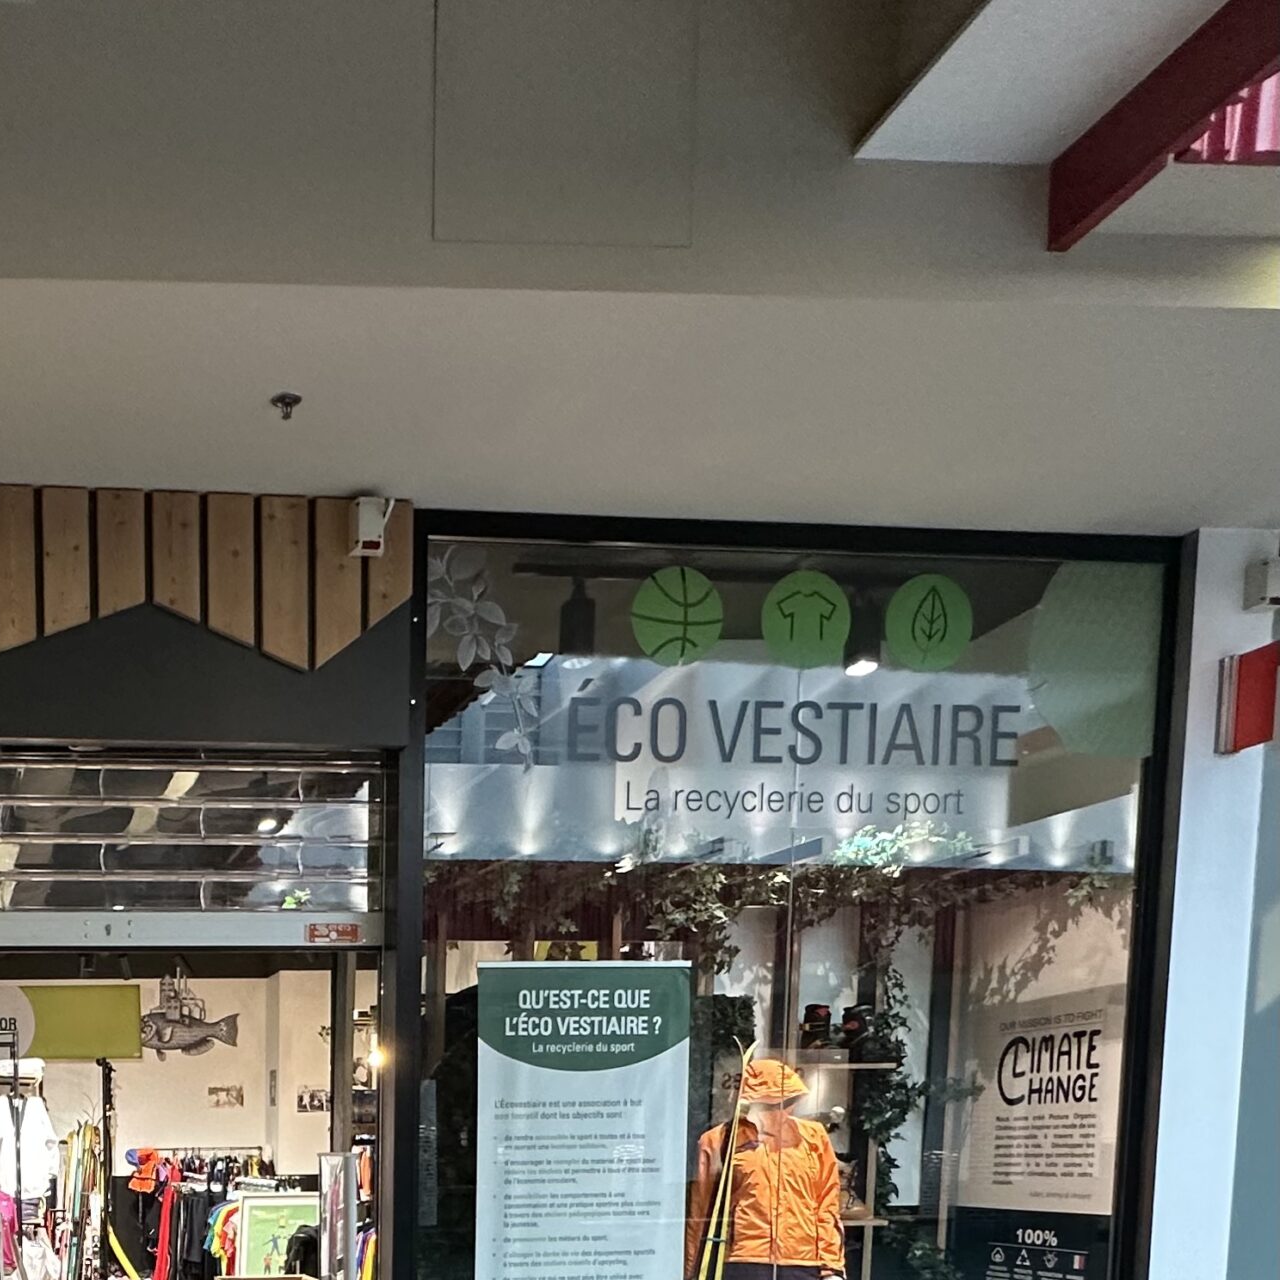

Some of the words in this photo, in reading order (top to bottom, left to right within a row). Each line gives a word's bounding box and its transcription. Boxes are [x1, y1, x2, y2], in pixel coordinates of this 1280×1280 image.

[568, 678, 686, 764] ÉCO
[709, 699, 1020, 767] VESTIAIRE
[626, 783, 659, 812] La
[674, 781, 823, 821] recyclerie
[837, 784, 873, 815] du
[885, 787, 964, 822] sport
[614, 989, 650, 1009] QUE
[557, 1016, 648, 1035] VESTIAIRE
[653, 1017, 662, 1035] ?
[532, 1042, 543, 1053] La
[546, 1042, 594, 1054] recyclerie
[596, 1042, 608, 1052] du
[610, 1043, 635, 1054] sport
[1016, 1229, 1058, 1247] 100%
